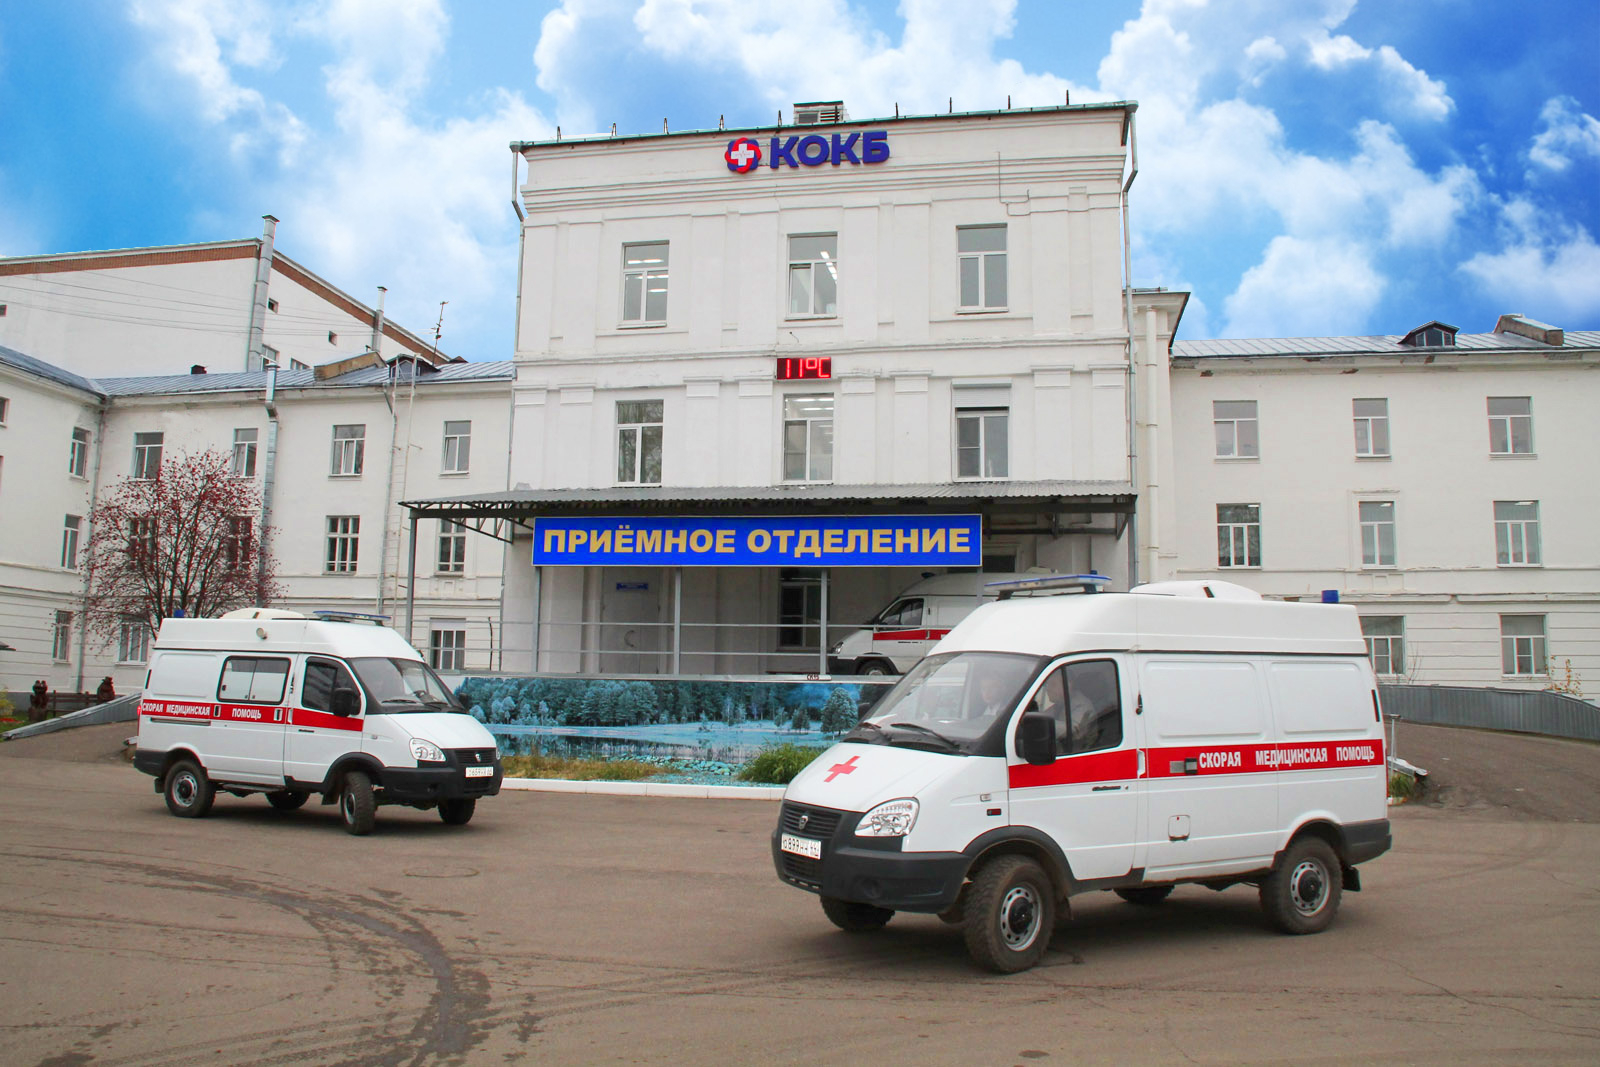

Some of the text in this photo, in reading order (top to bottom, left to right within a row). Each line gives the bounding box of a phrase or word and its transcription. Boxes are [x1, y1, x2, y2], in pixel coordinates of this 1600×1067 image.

[769, 131, 890, 169] КОКБ
[543, 524, 970, 558] ПРИЁМНОЕ ОТДЕЛЕНИЕ
[142, 702, 262, 720] СКОРАЯ МЕДИЦИНСКАЯ ПОМОЩЬ
[1199, 745, 1375, 769] СКОРАЯ МЕДИЦИНСКАЯ ПОМОЩЬ
